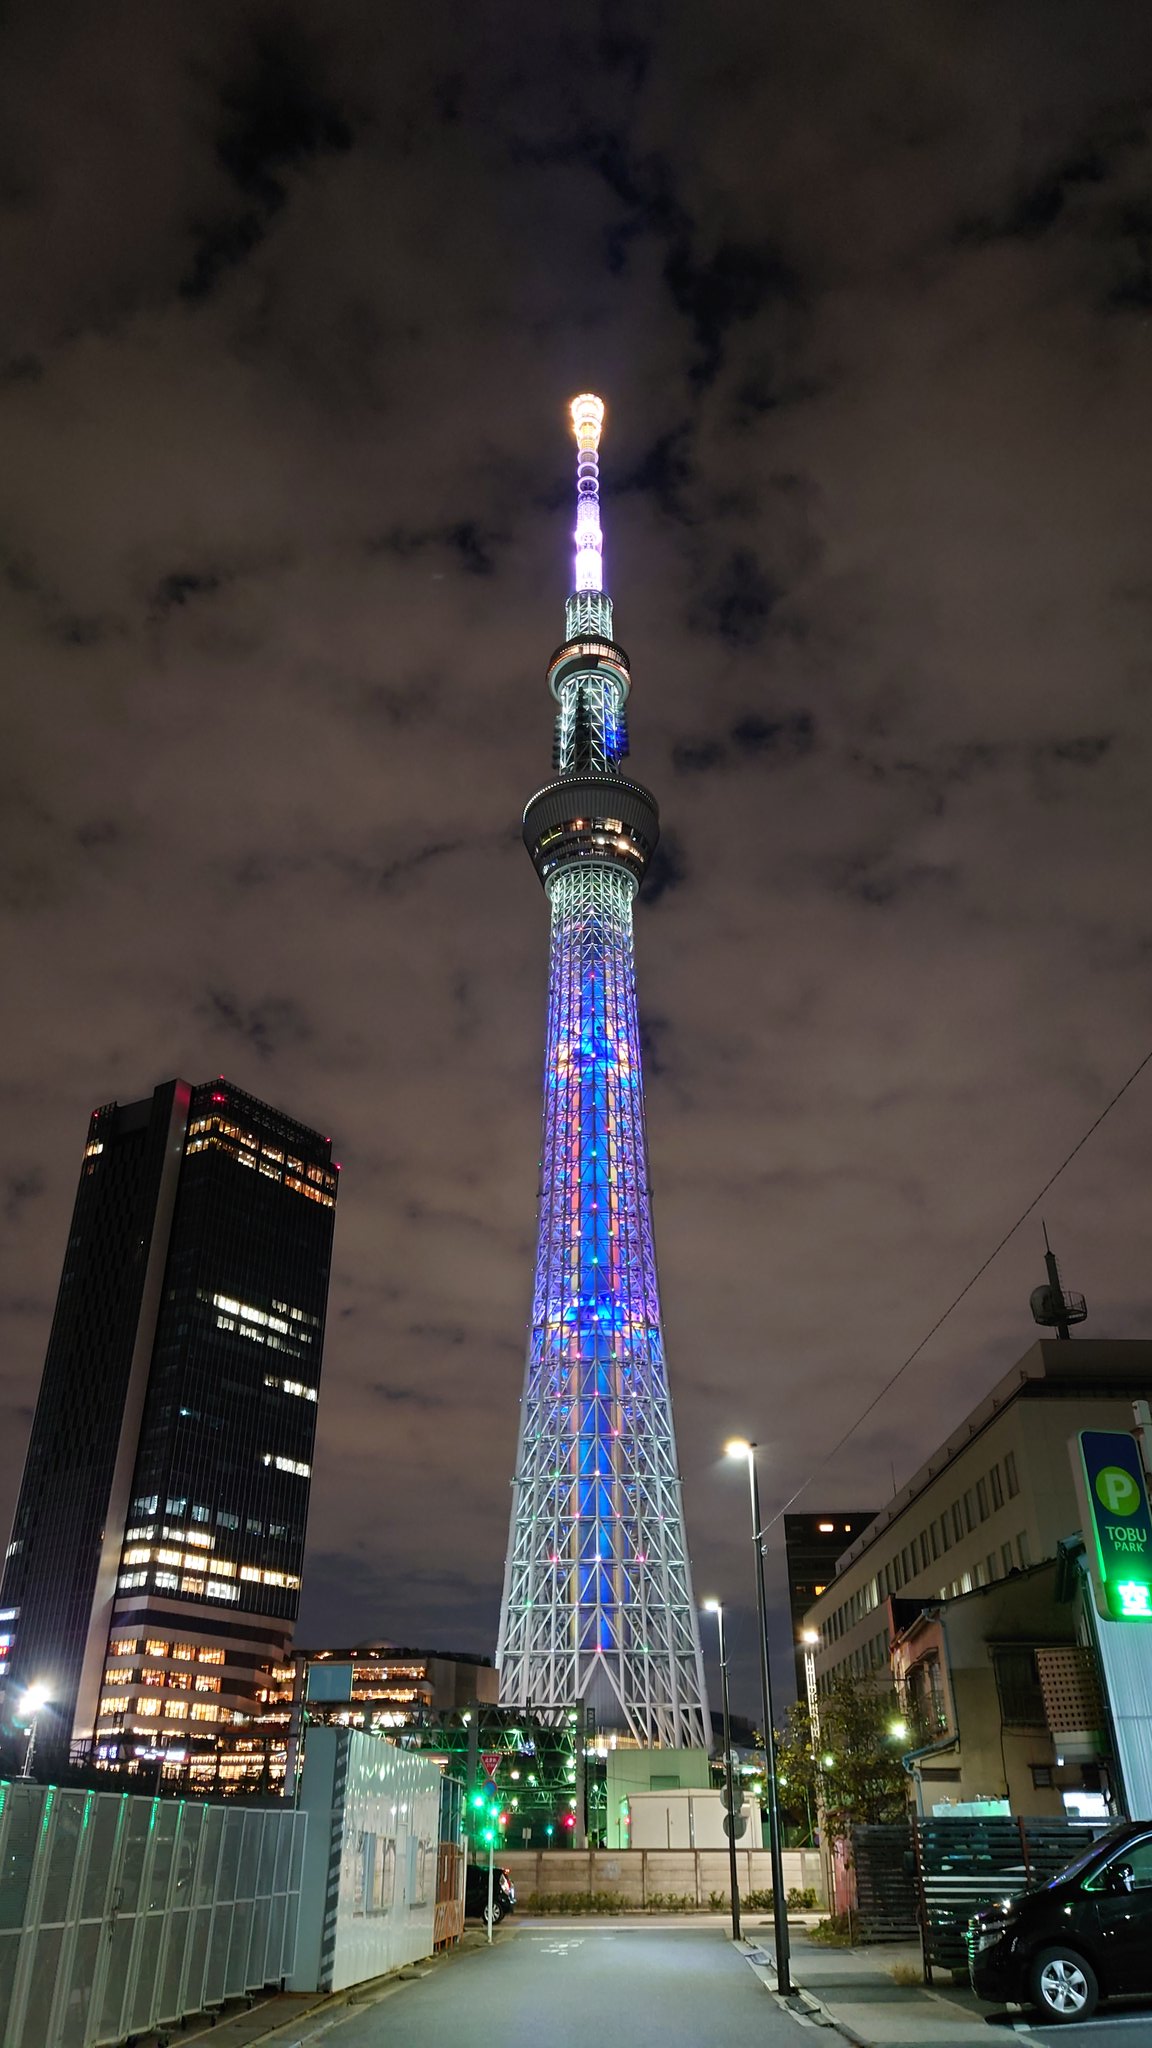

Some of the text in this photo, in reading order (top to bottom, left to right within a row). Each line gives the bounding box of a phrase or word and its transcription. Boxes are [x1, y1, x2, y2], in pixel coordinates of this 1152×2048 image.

[1104, 1474, 1132, 1510] P
[1105, 1526, 1147, 1542] TOBU
[1114, 1541, 1144, 1552] PARK
